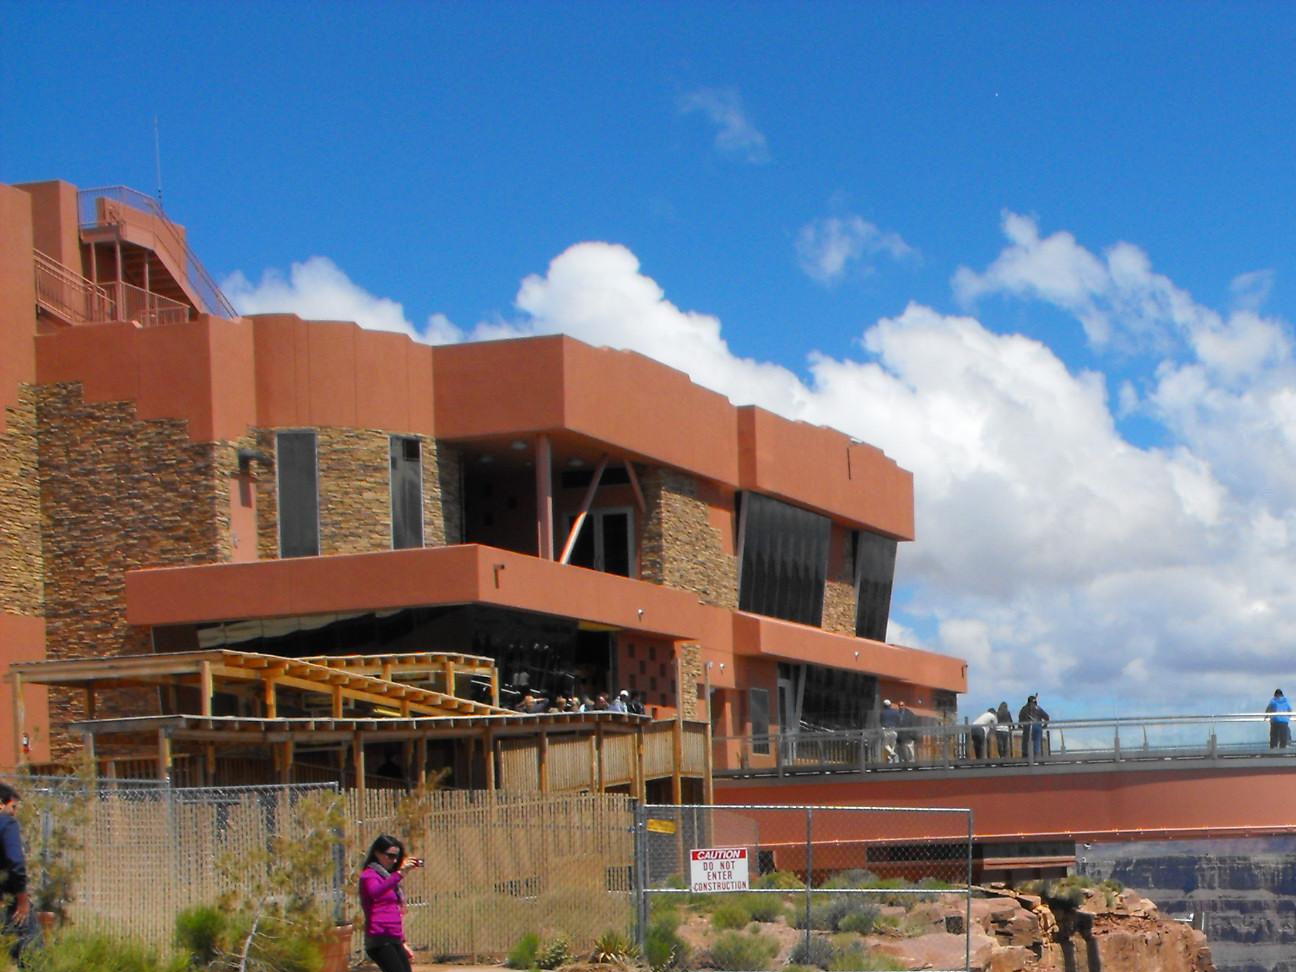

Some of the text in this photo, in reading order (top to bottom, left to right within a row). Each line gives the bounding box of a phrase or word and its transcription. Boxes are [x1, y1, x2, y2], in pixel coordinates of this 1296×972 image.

[697, 850, 740, 860] CAUTION
[703, 861, 736, 871] DO NOT
[707, 871, 733, 880] ENTER
[693, 881, 747, 891] CONSTRUCTION
